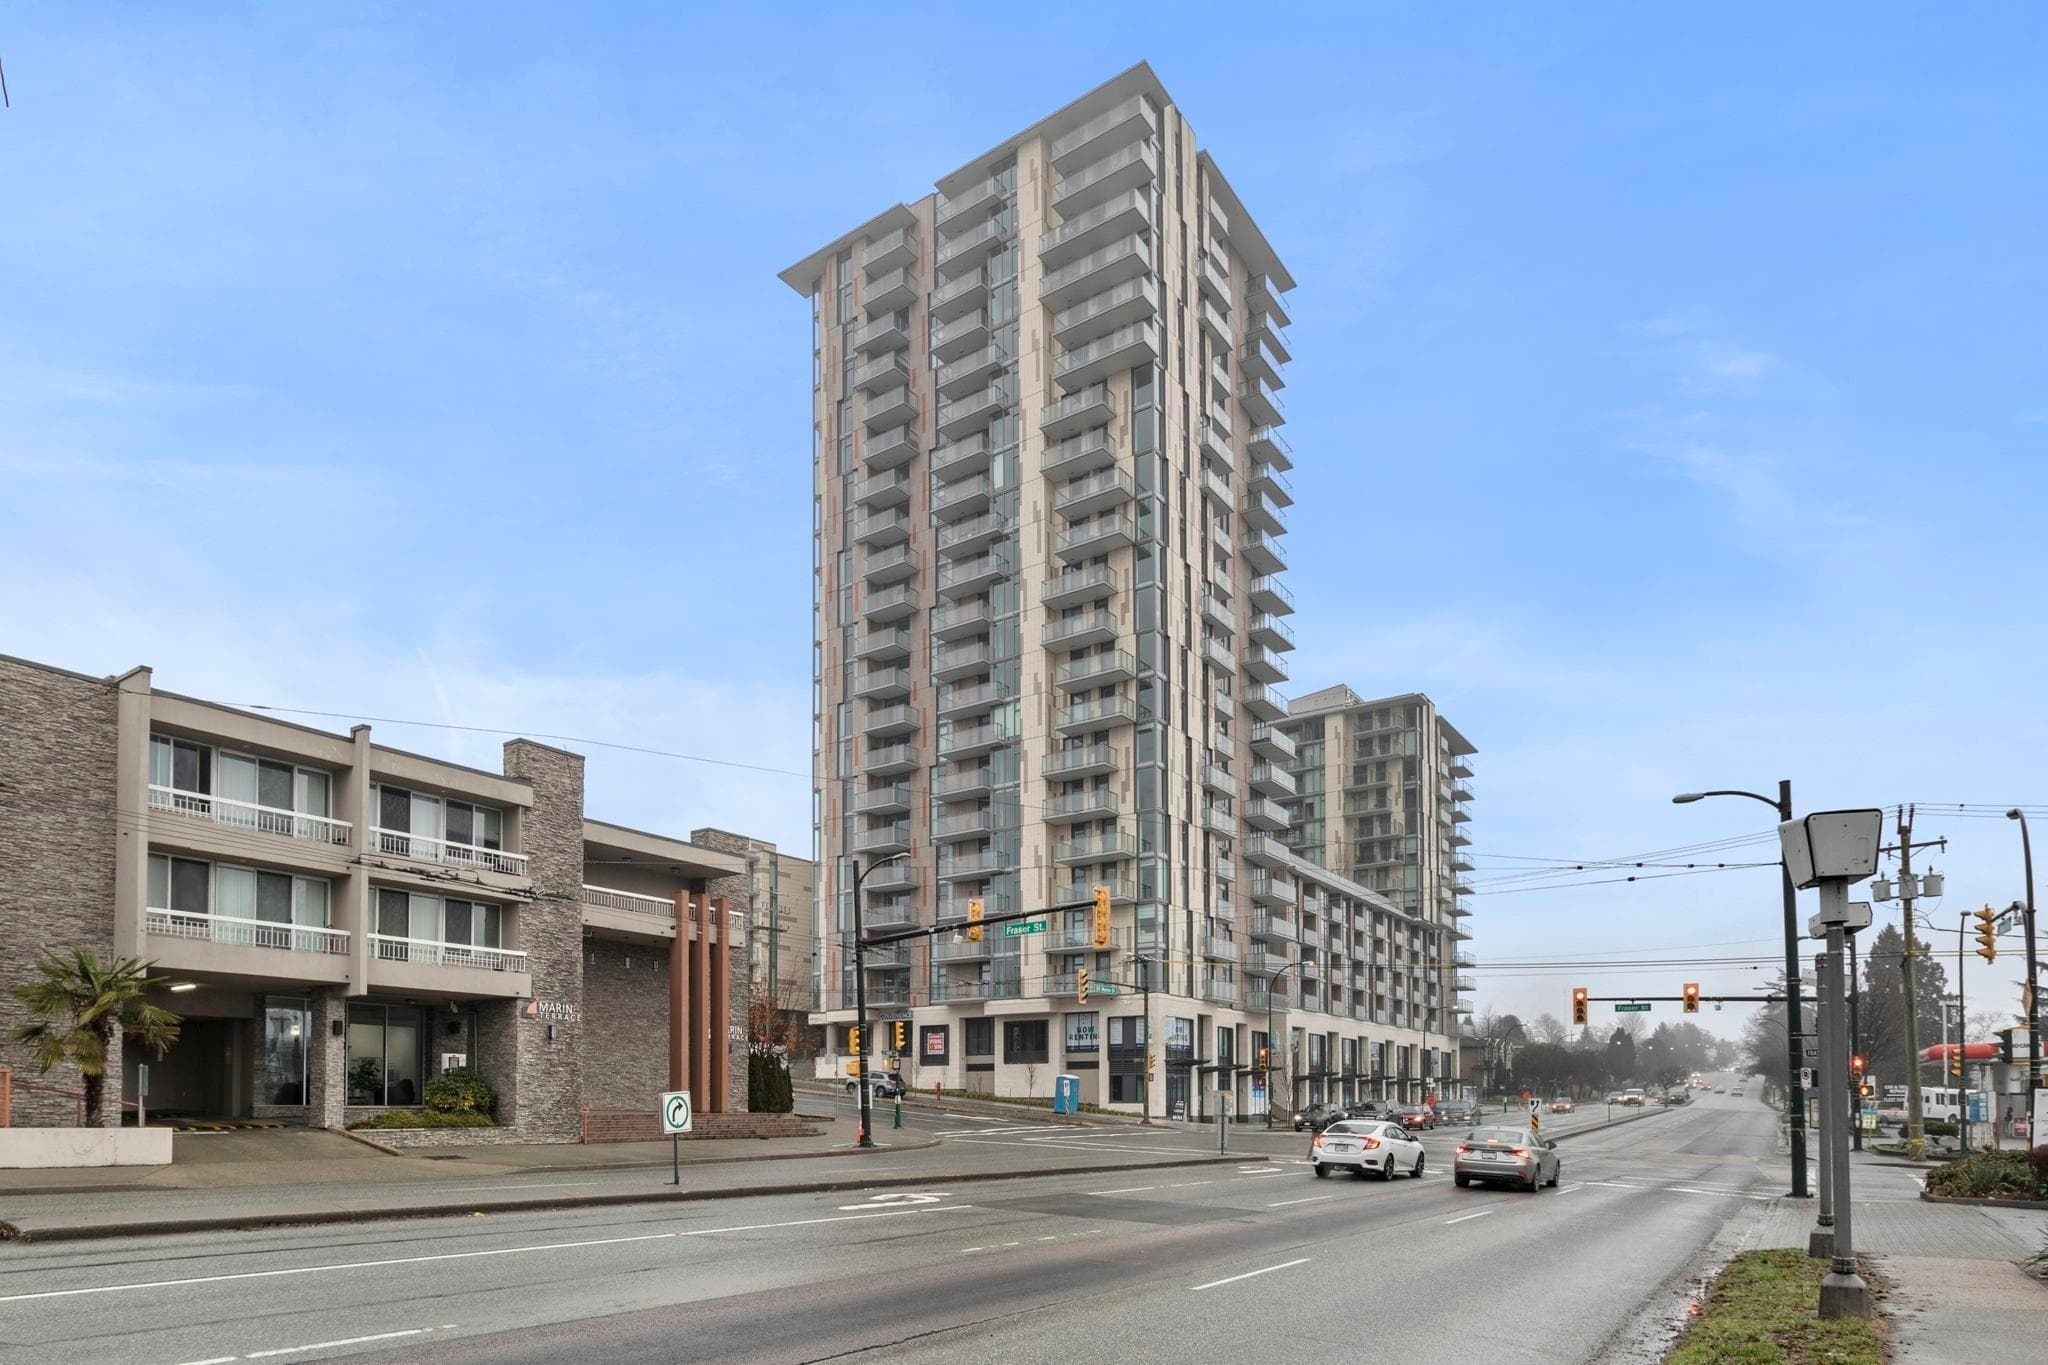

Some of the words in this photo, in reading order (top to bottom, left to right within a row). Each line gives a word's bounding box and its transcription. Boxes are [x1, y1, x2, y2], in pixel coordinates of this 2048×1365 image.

[1006, 924, 1030, 936] Fraser
[539, 1012, 582, 1021] TERRACE
[1069, 1033, 1099, 1041] RENTIN
